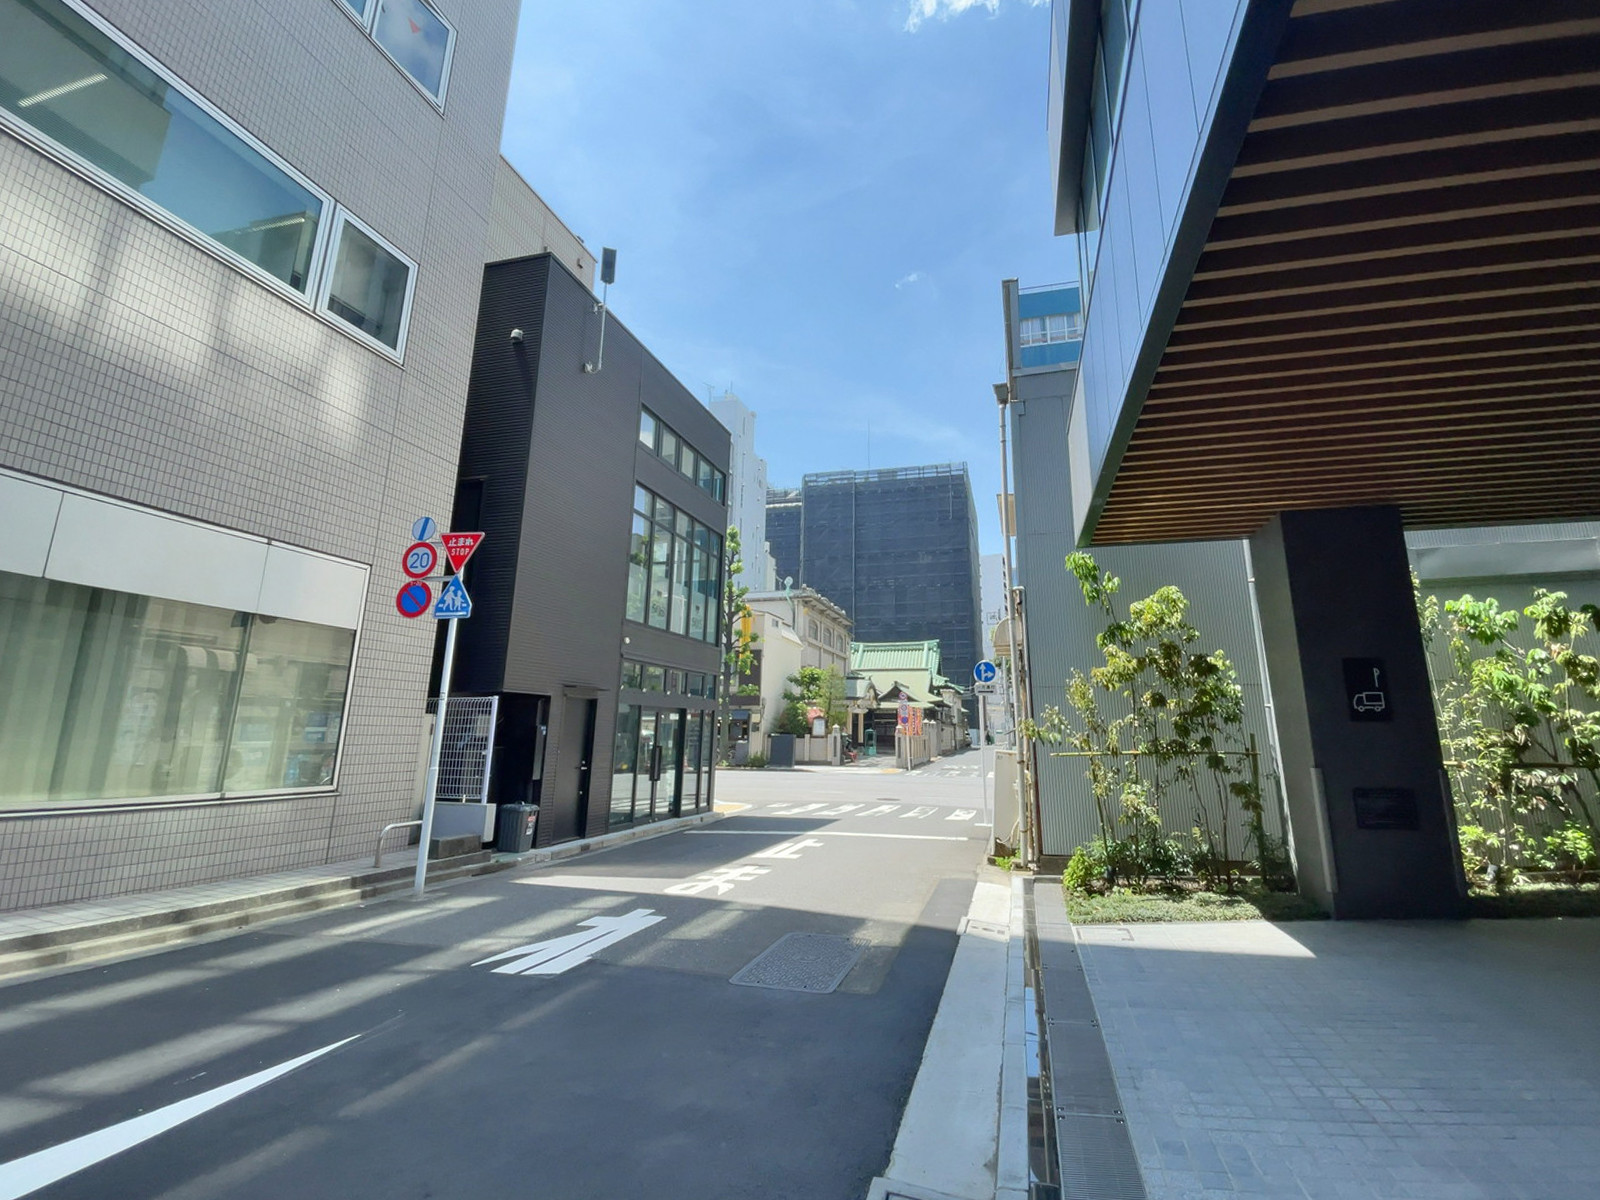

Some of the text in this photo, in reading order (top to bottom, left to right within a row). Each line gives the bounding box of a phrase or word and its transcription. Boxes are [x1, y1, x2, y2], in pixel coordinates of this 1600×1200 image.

[448, 537, 474, 547] 止まれ
[451, 548, 469, 556] STOP
[409, 552, 430, 569] 20
[470, 838, 824, 976] 止まれ
